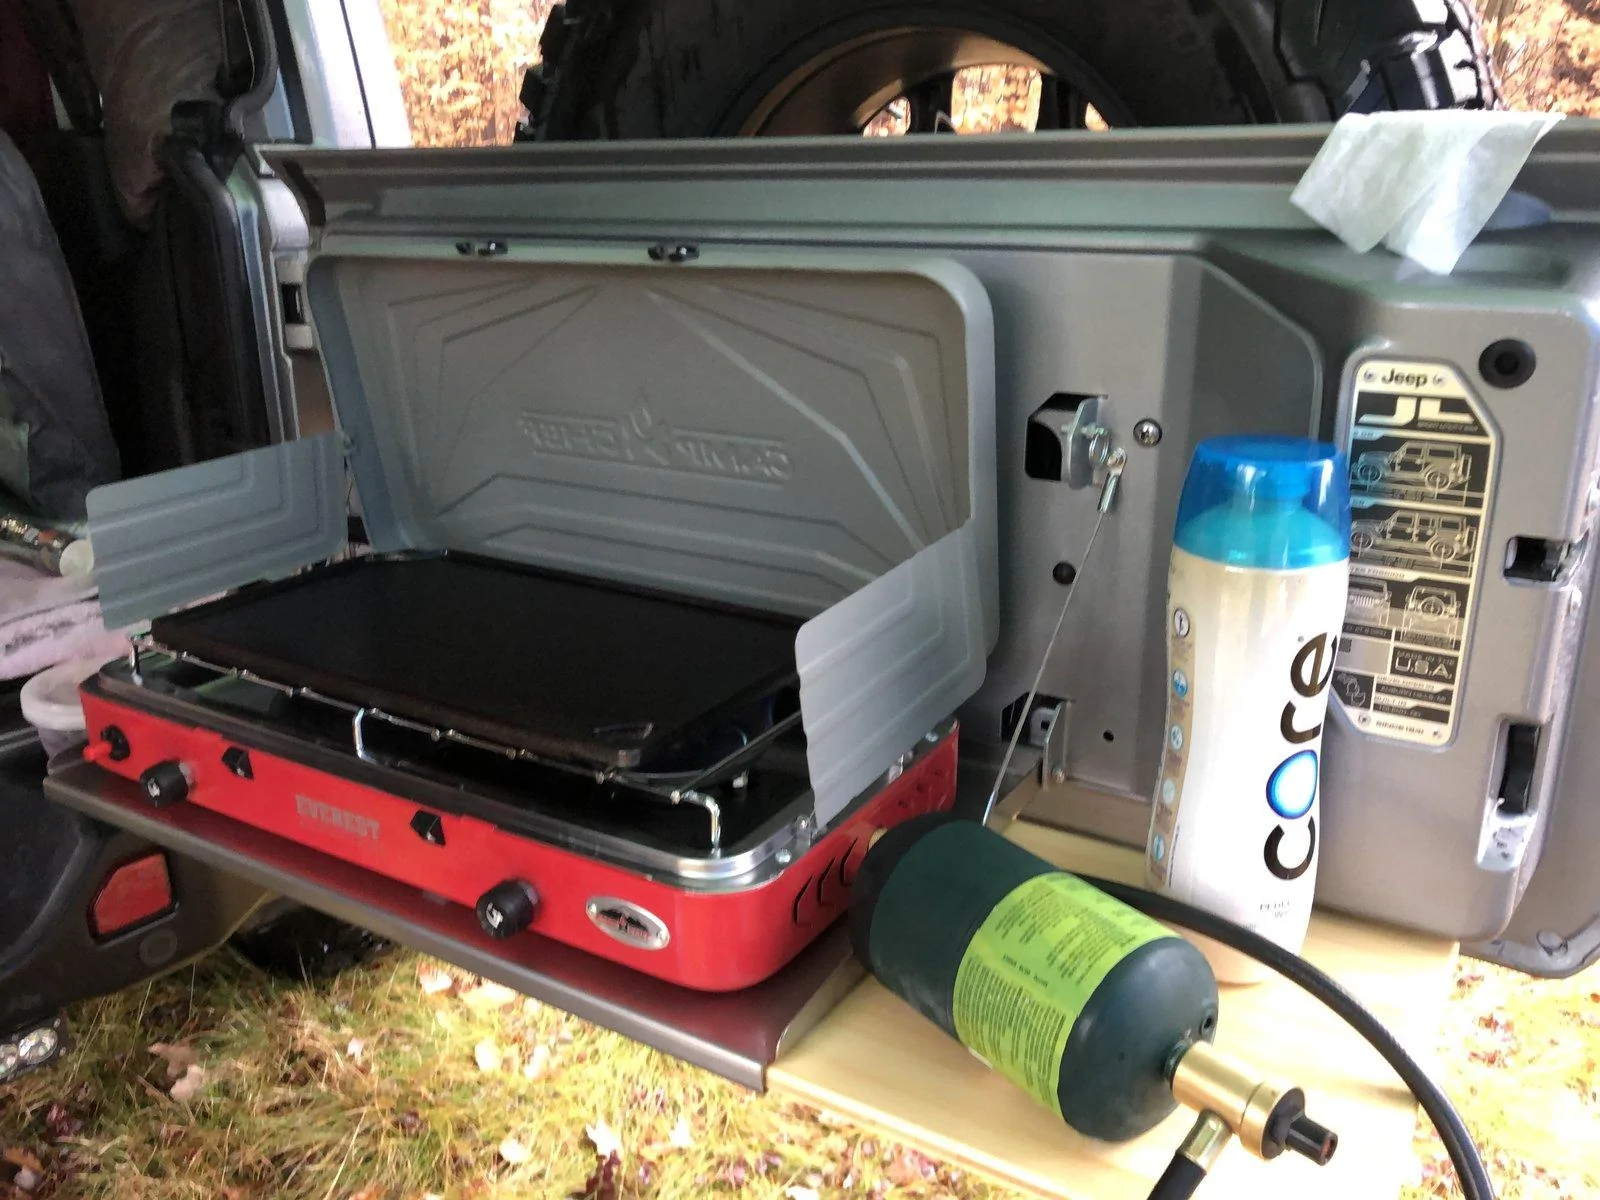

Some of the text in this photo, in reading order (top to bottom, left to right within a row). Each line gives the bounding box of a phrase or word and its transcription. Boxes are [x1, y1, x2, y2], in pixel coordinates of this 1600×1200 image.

[1381, 368, 1428, 388] Jeep
[1358, 396, 1475, 426] JL
[1263, 631, 1338, 880] core
[294, 793, 381, 840] EVEREST
